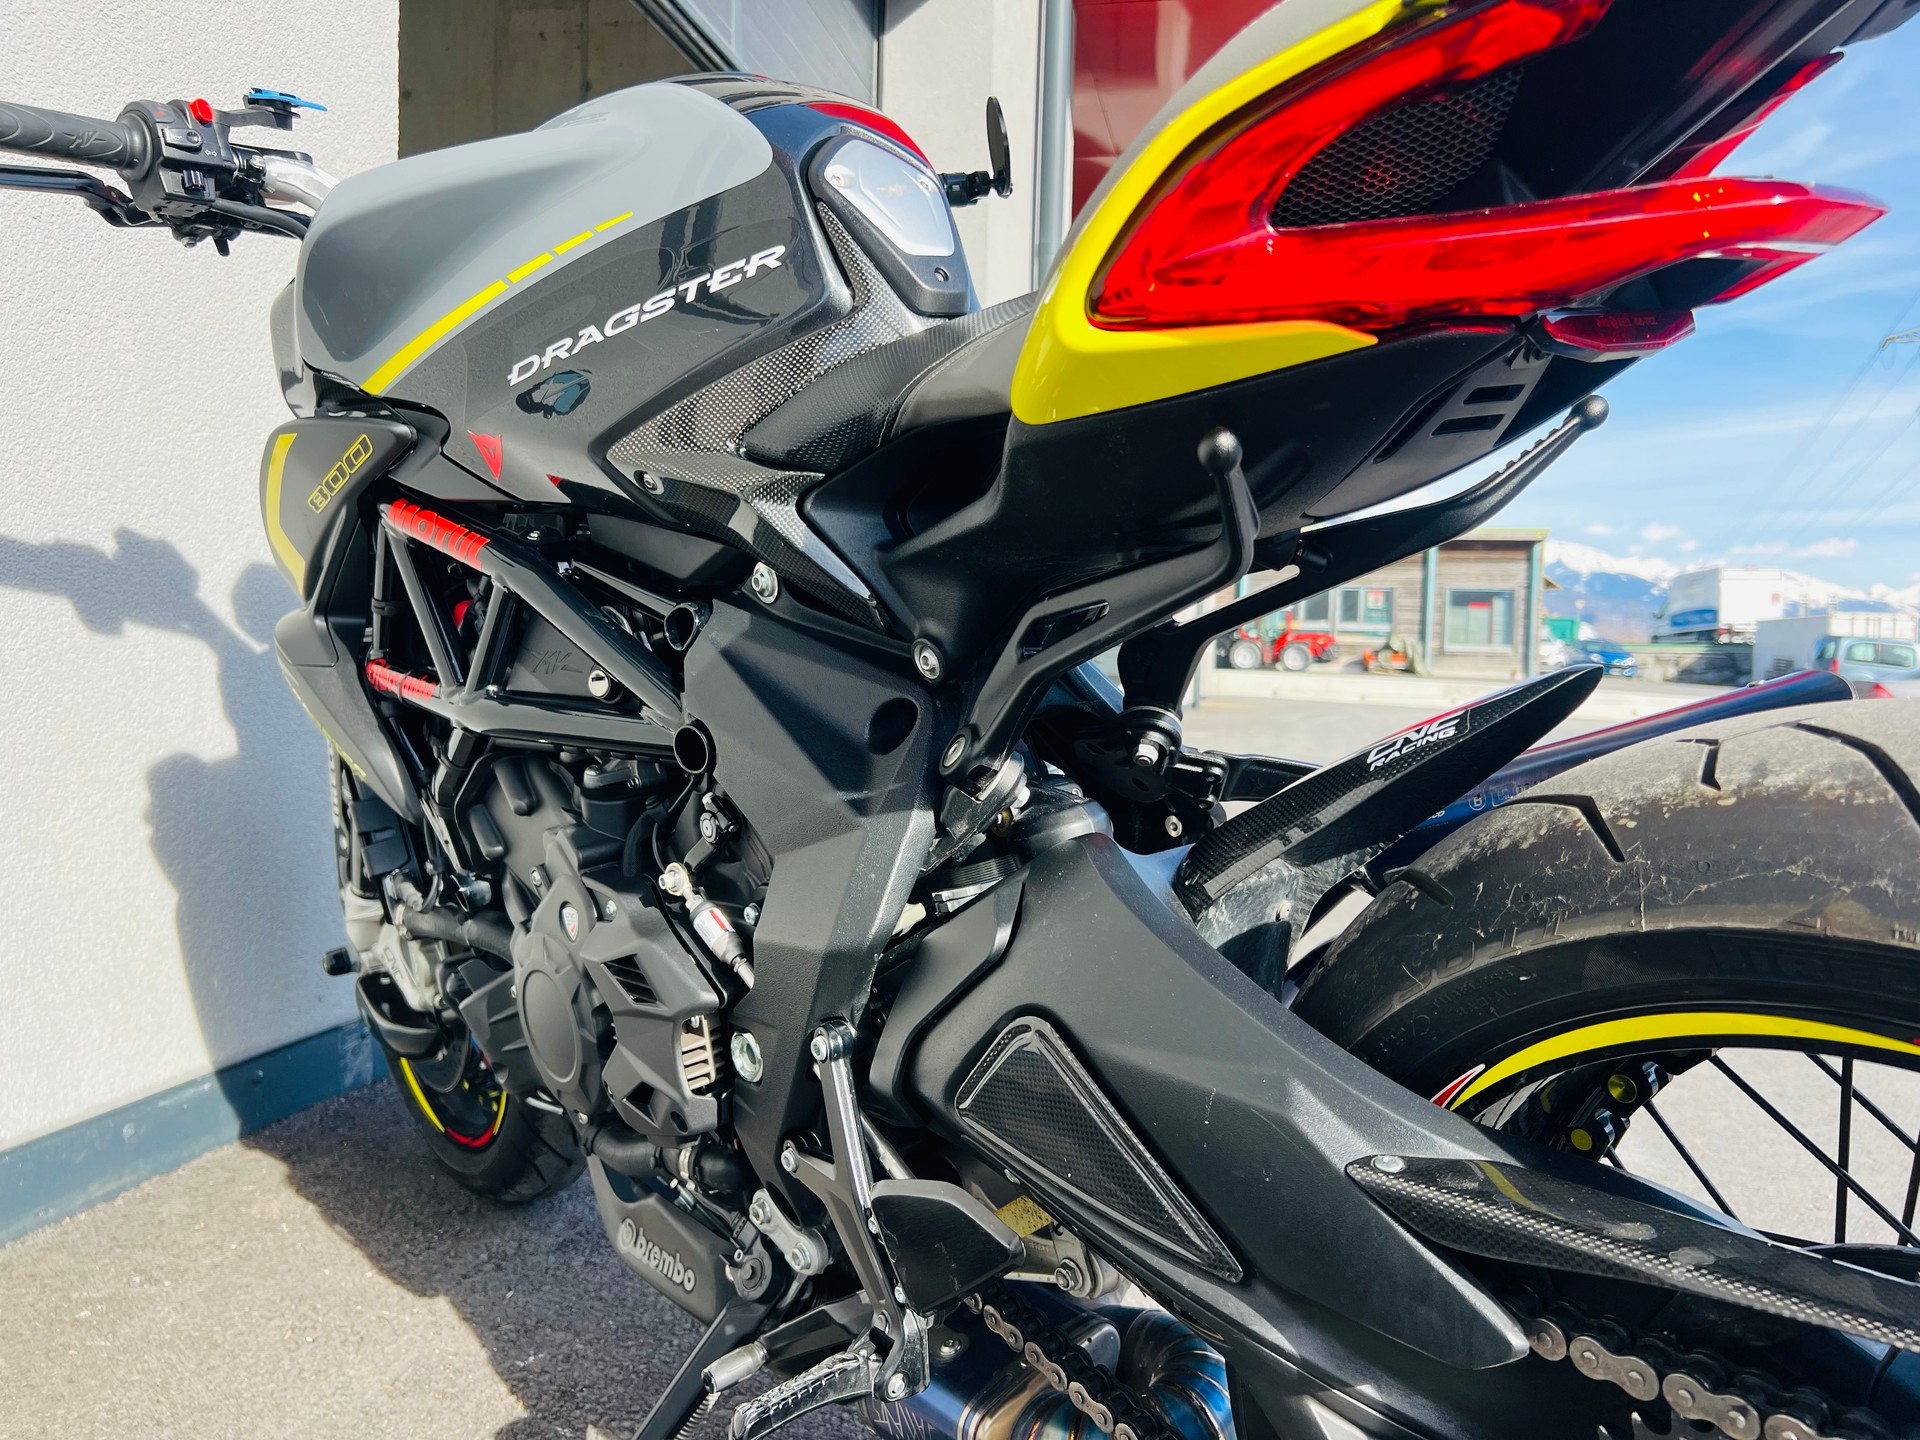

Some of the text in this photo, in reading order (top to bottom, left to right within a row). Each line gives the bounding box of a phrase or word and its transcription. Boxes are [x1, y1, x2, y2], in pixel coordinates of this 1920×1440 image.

[507, 245, 786, 387] DRAGSTER
[308, 434, 373, 514] 800
[387, 498, 491, 571] MOTUL
[1366, 709, 1467, 764] CNC
[1369, 726, 1457, 772] RACING
[635, 1226, 696, 1292] brembo
